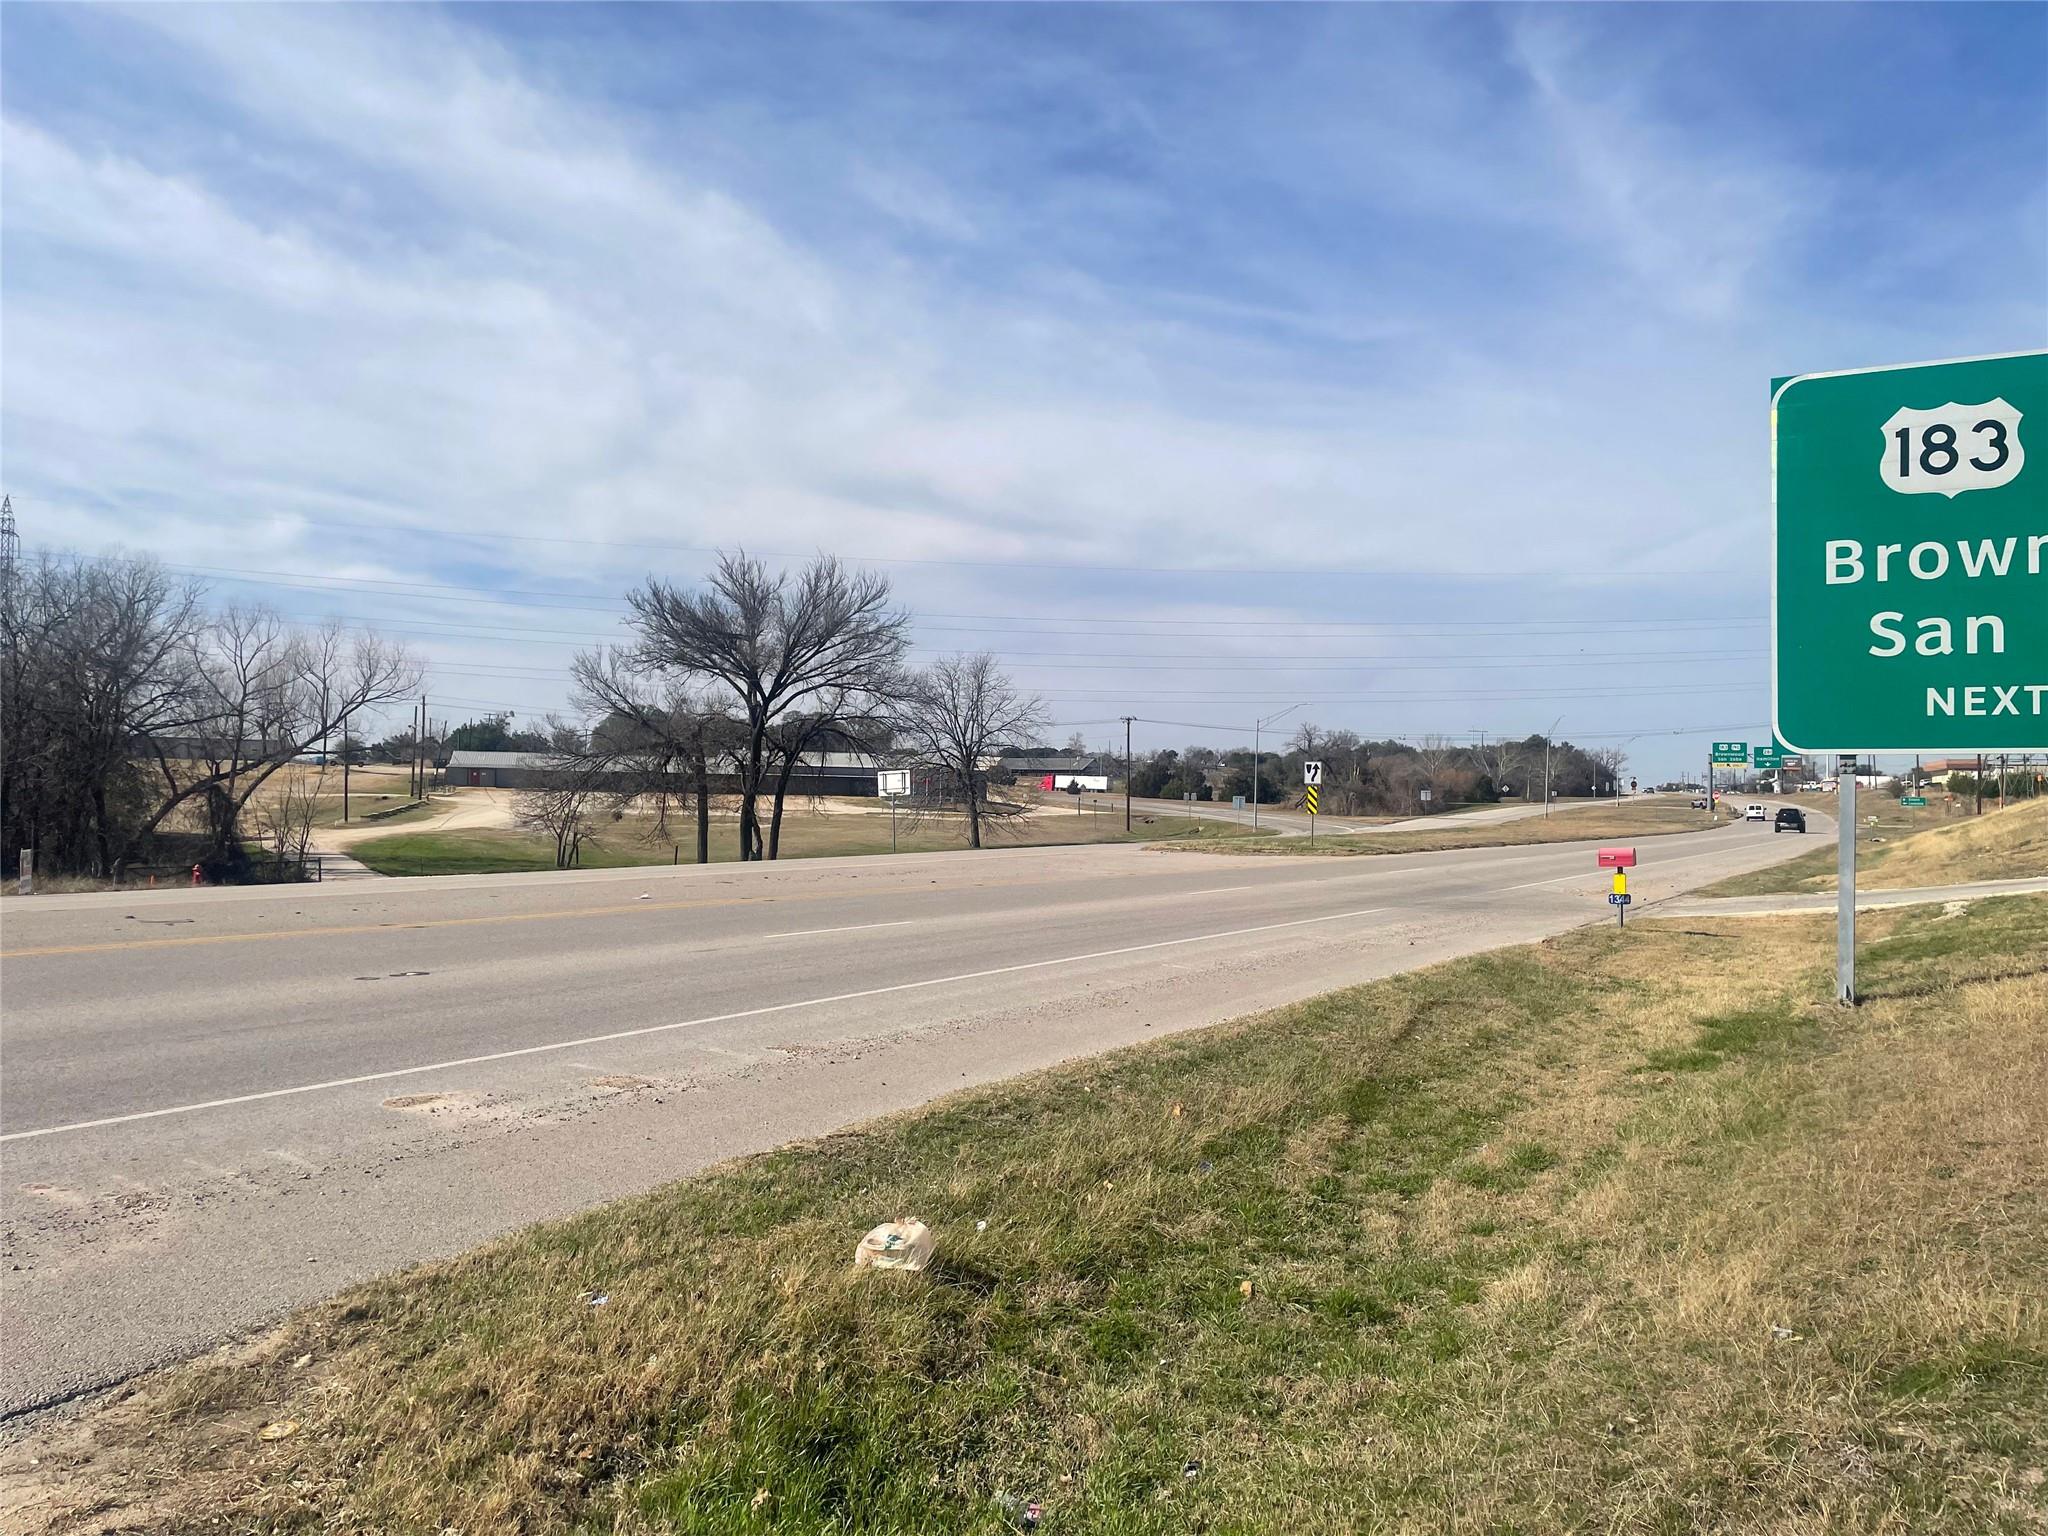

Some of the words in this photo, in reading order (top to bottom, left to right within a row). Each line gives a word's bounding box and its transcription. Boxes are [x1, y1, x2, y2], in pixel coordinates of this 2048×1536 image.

[1895, 419, 2009, 477] 183
[1869, 611, 2005, 657] San
[1927, 685, 2048, 716] NEXT
